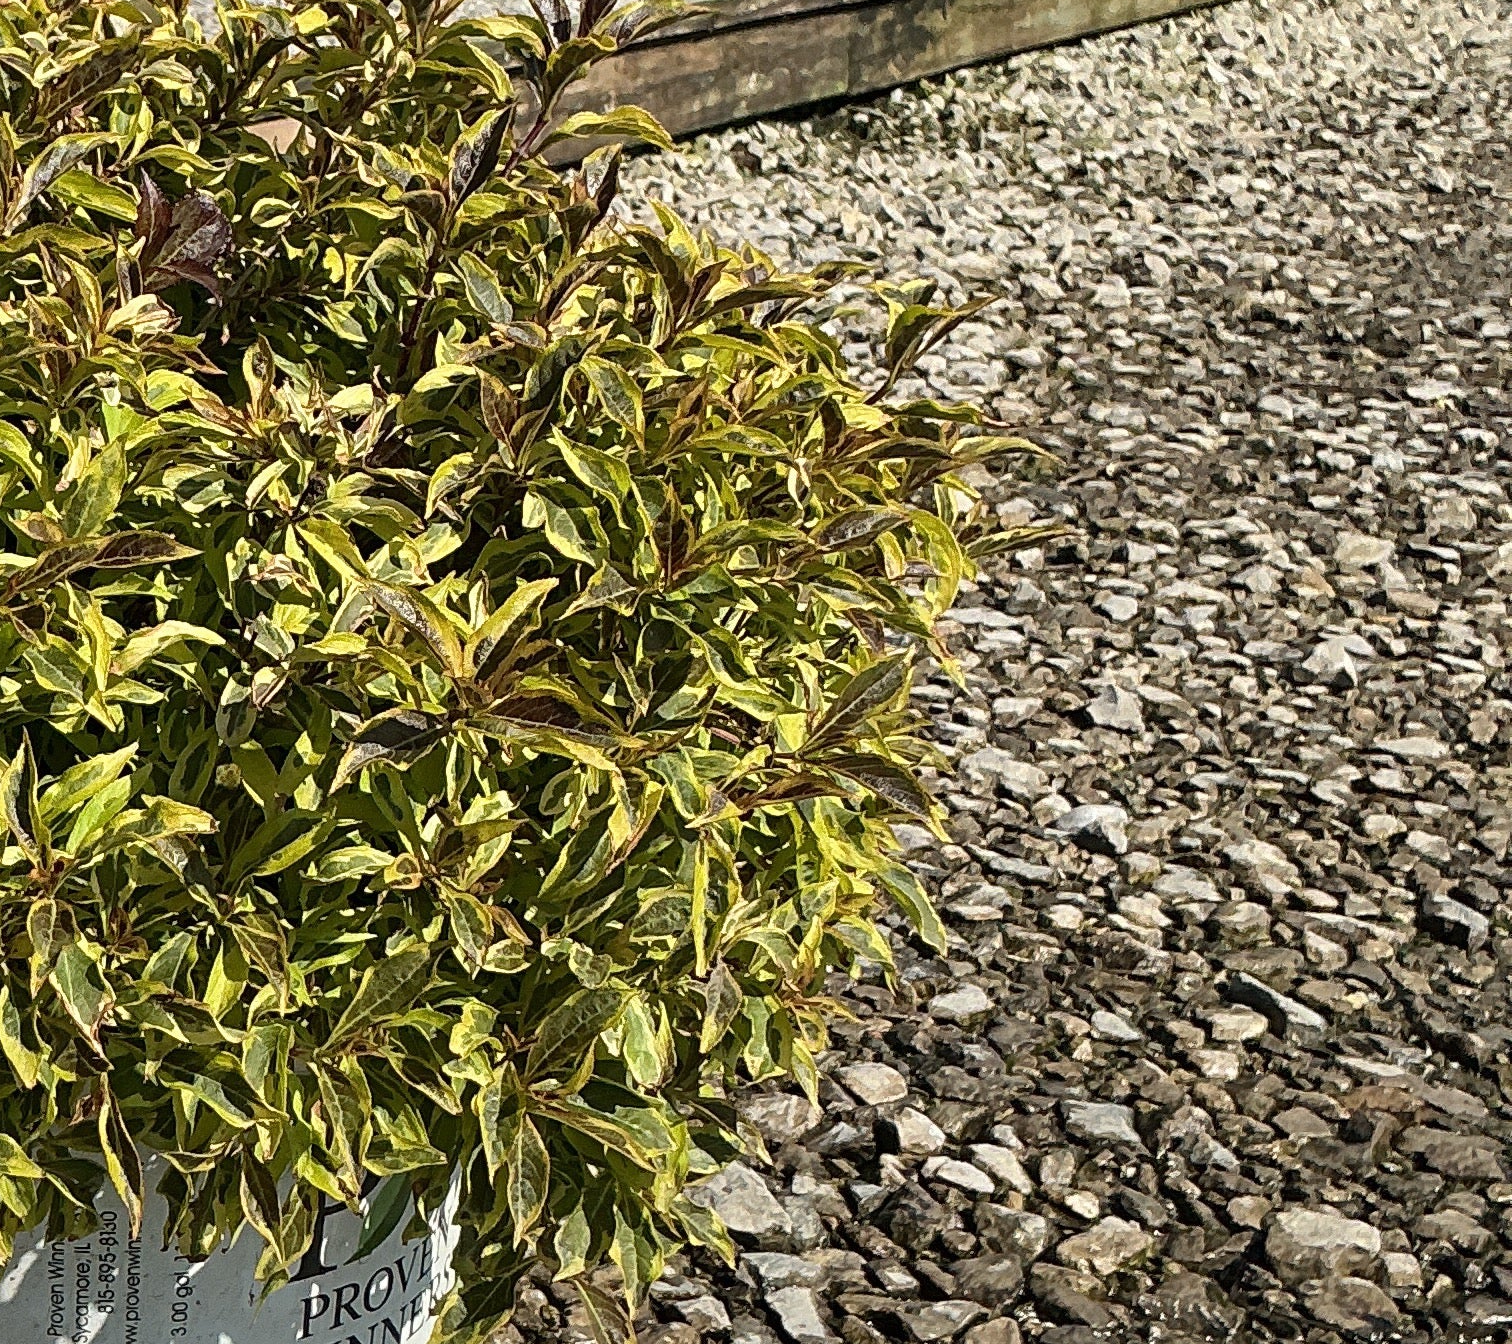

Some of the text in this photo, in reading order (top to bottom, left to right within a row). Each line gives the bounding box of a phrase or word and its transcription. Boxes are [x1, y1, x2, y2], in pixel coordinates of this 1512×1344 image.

[46, 1241, 66, 1337] Proven Winn
[71, 1242, 93, 1344] Sycamore, IL
[97, 1210, 118, 1315] 815-895-8130
[170, 1302, 189, 1337] 3.00
